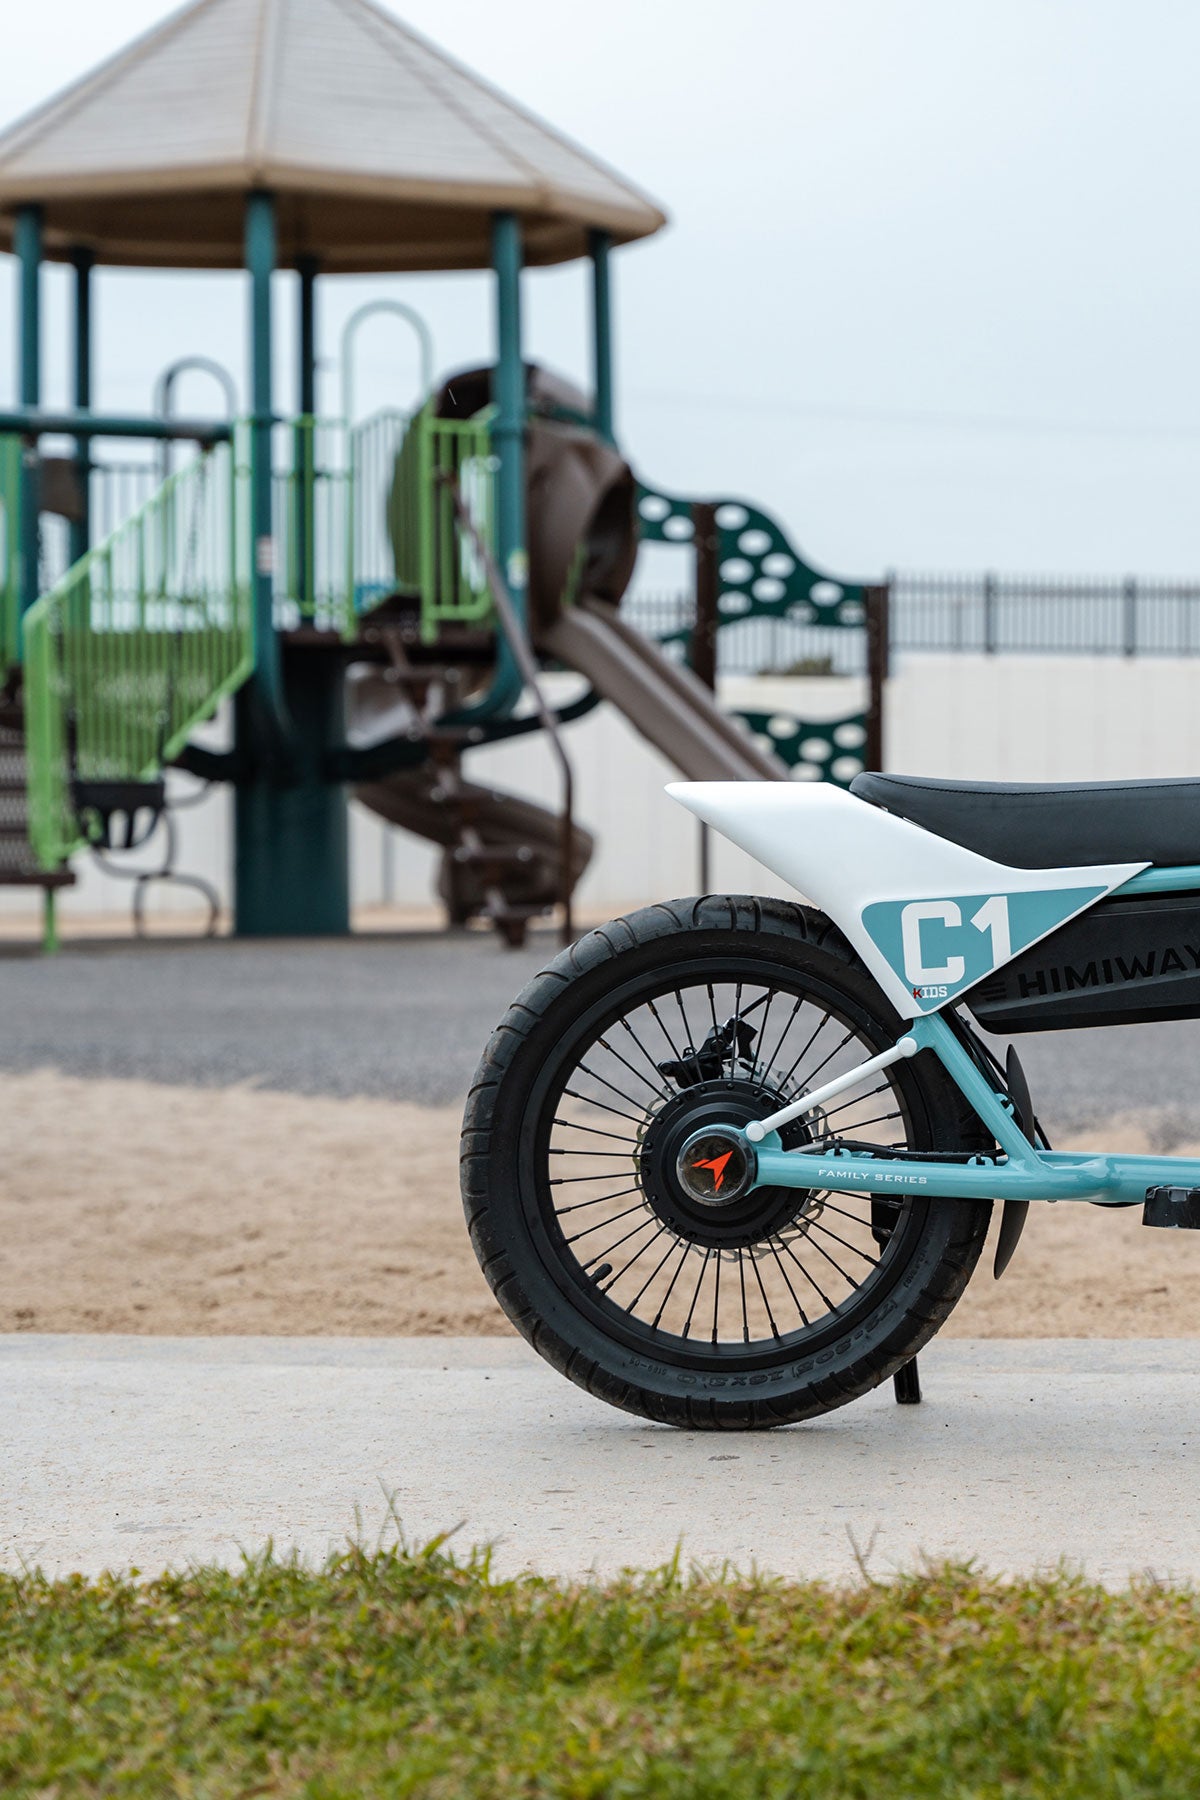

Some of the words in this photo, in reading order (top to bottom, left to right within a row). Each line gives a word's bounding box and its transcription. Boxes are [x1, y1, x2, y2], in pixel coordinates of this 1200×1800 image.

[901, 895, 1012, 986] C1
[912, 986, 948, 999] KIDS
[818, 1169, 869, 1180] FAMILY
[875, 1174, 927, 1184] SERIES
